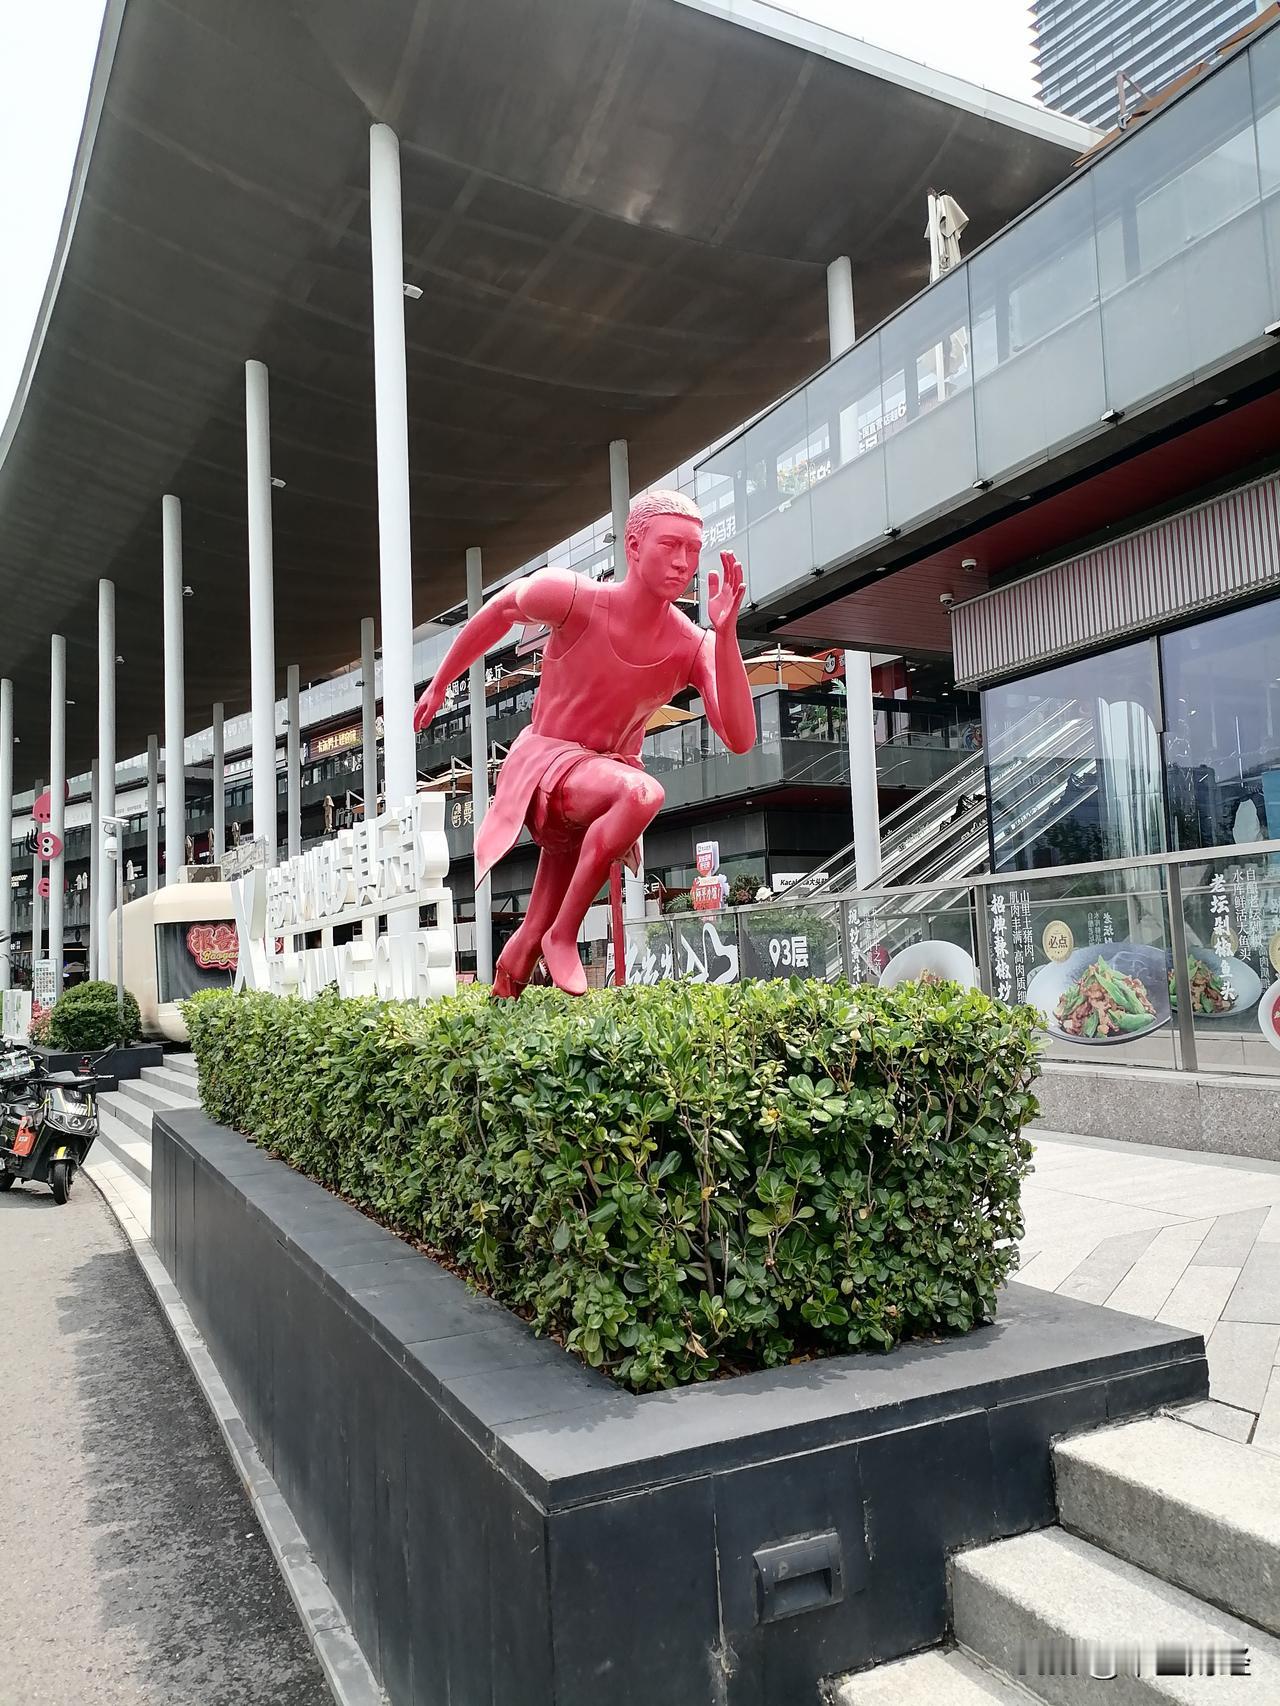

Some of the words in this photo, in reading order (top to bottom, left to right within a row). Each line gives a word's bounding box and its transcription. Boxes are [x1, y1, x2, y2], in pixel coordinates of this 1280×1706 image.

[847, 909, 862, 988] 现炒黄牛
[990, 894, 1012, 1002] 招牌辣椒炒
[1048, 935, 1068, 949] 必点
[1209, 873, 1236, 1001] 老坛剁椒鱼头
[1232, 869, 1252, 962] 水库鲜活大鱼头
